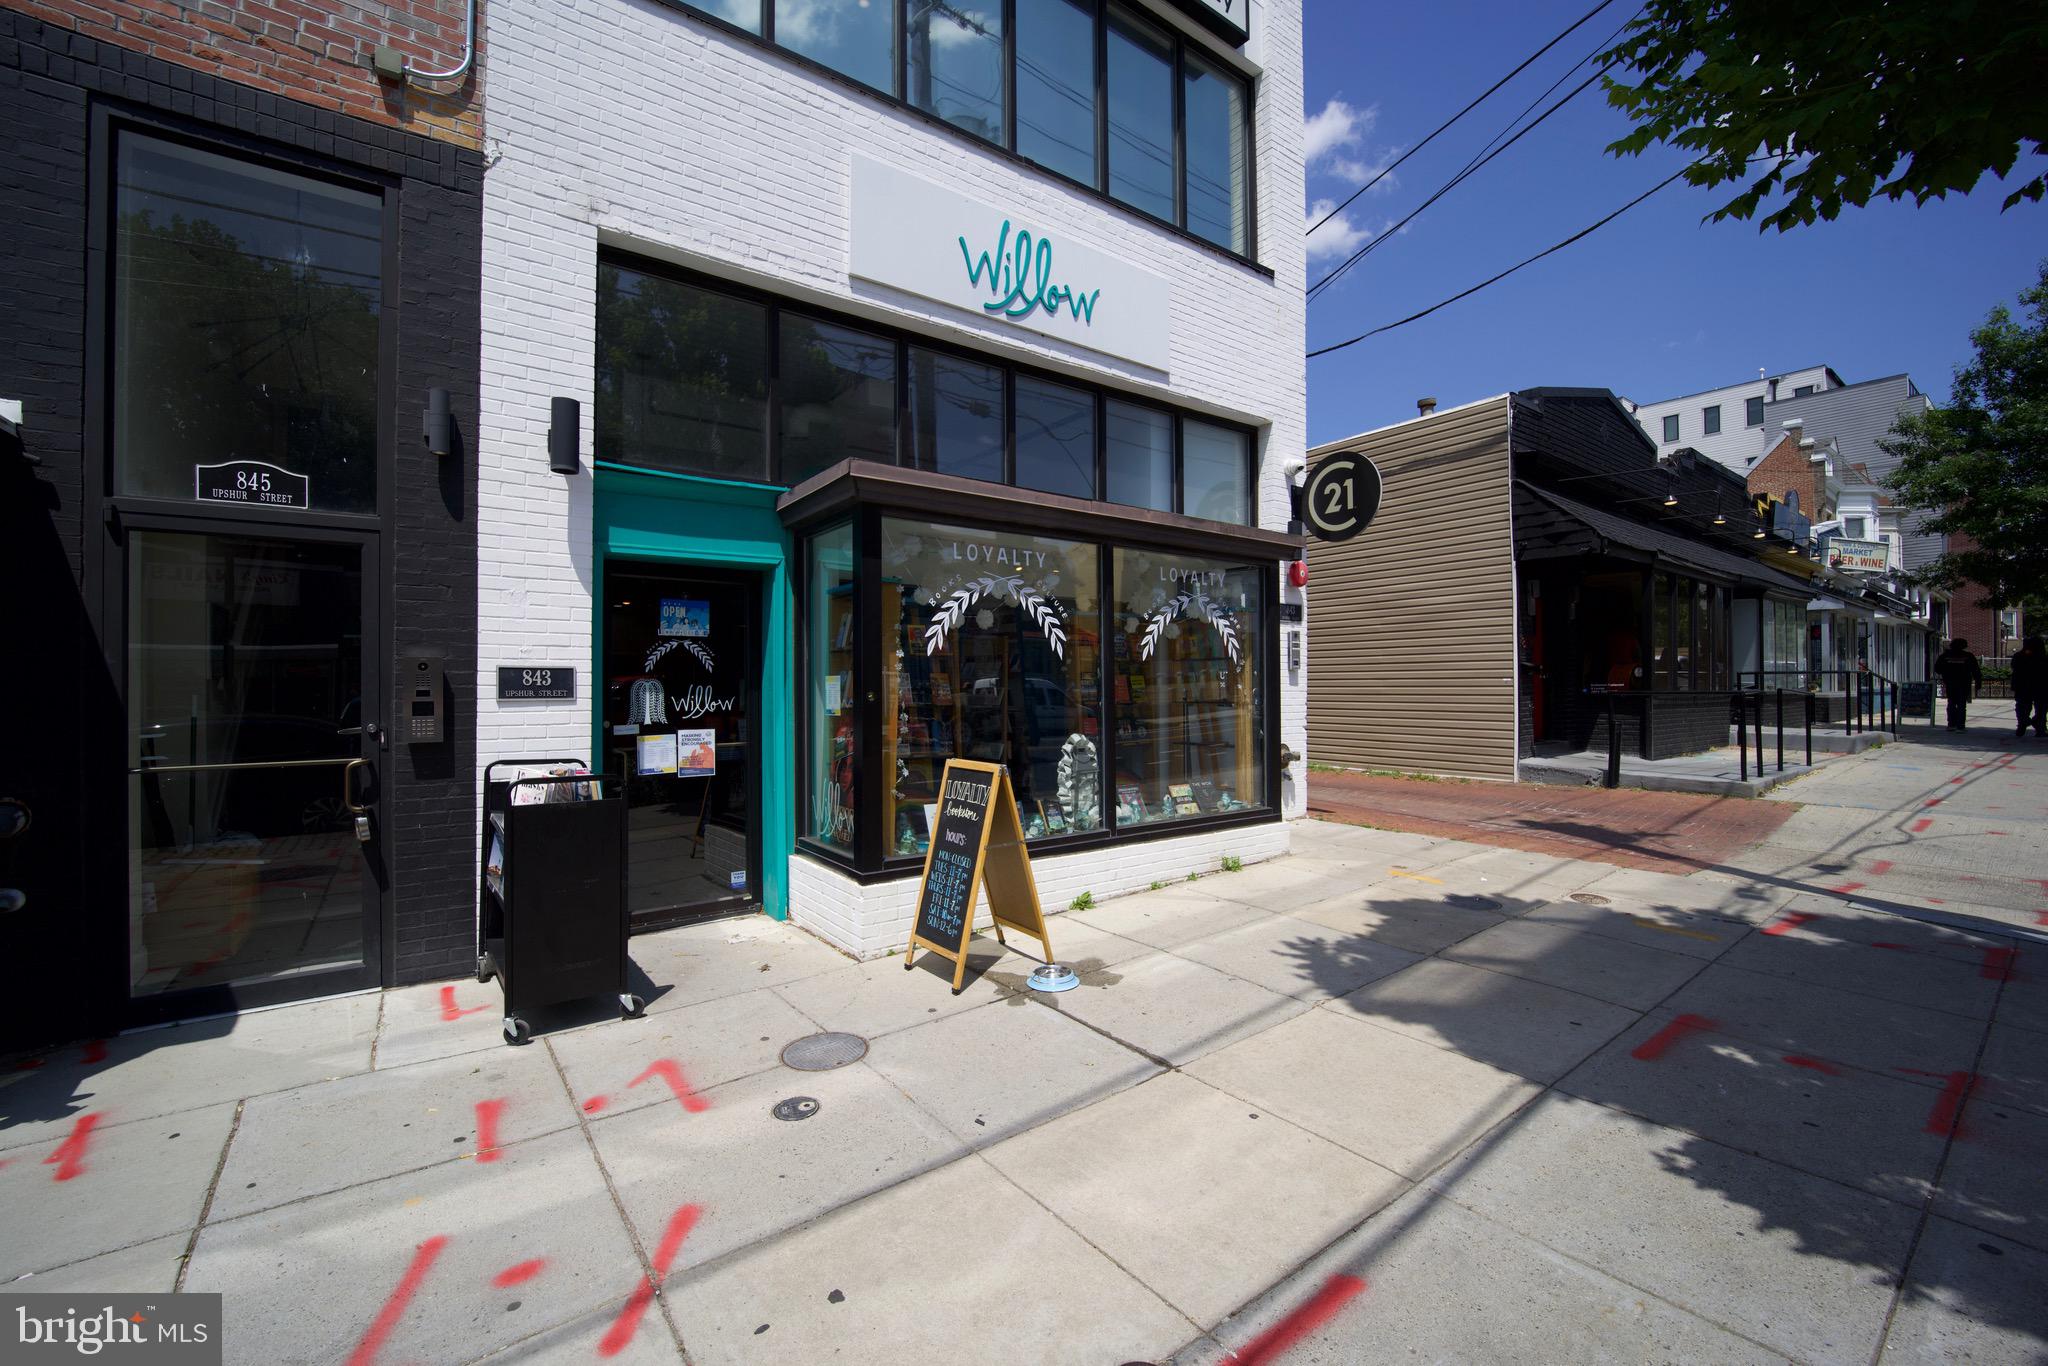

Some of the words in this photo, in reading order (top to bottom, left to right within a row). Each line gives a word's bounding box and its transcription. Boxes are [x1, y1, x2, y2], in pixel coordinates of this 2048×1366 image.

[958, 219, 1100, 323] Willow
[237, 471, 271, 491] 845
[212, 488, 248, 500] UPSHUR
[260, 492, 293, 504] STREET
[953, 542, 1046, 569] LOYALTY
[1842, 547, 1874, 557] MARKET
[1860, 557, 1884, 569] WINE
[1160, 566, 1226, 588] LOYALTY
[928, 573, 962, 608] BOOKS
[663, 606, 686, 618] OPEN
[522, 669, 552, 686] 843
[505, 689, 535, 697] UPSHUR
[538, 689, 568, 697] STREET
[671, 684, 736, 719] Willow
[944, 780, 991, 806] LOYALTY
